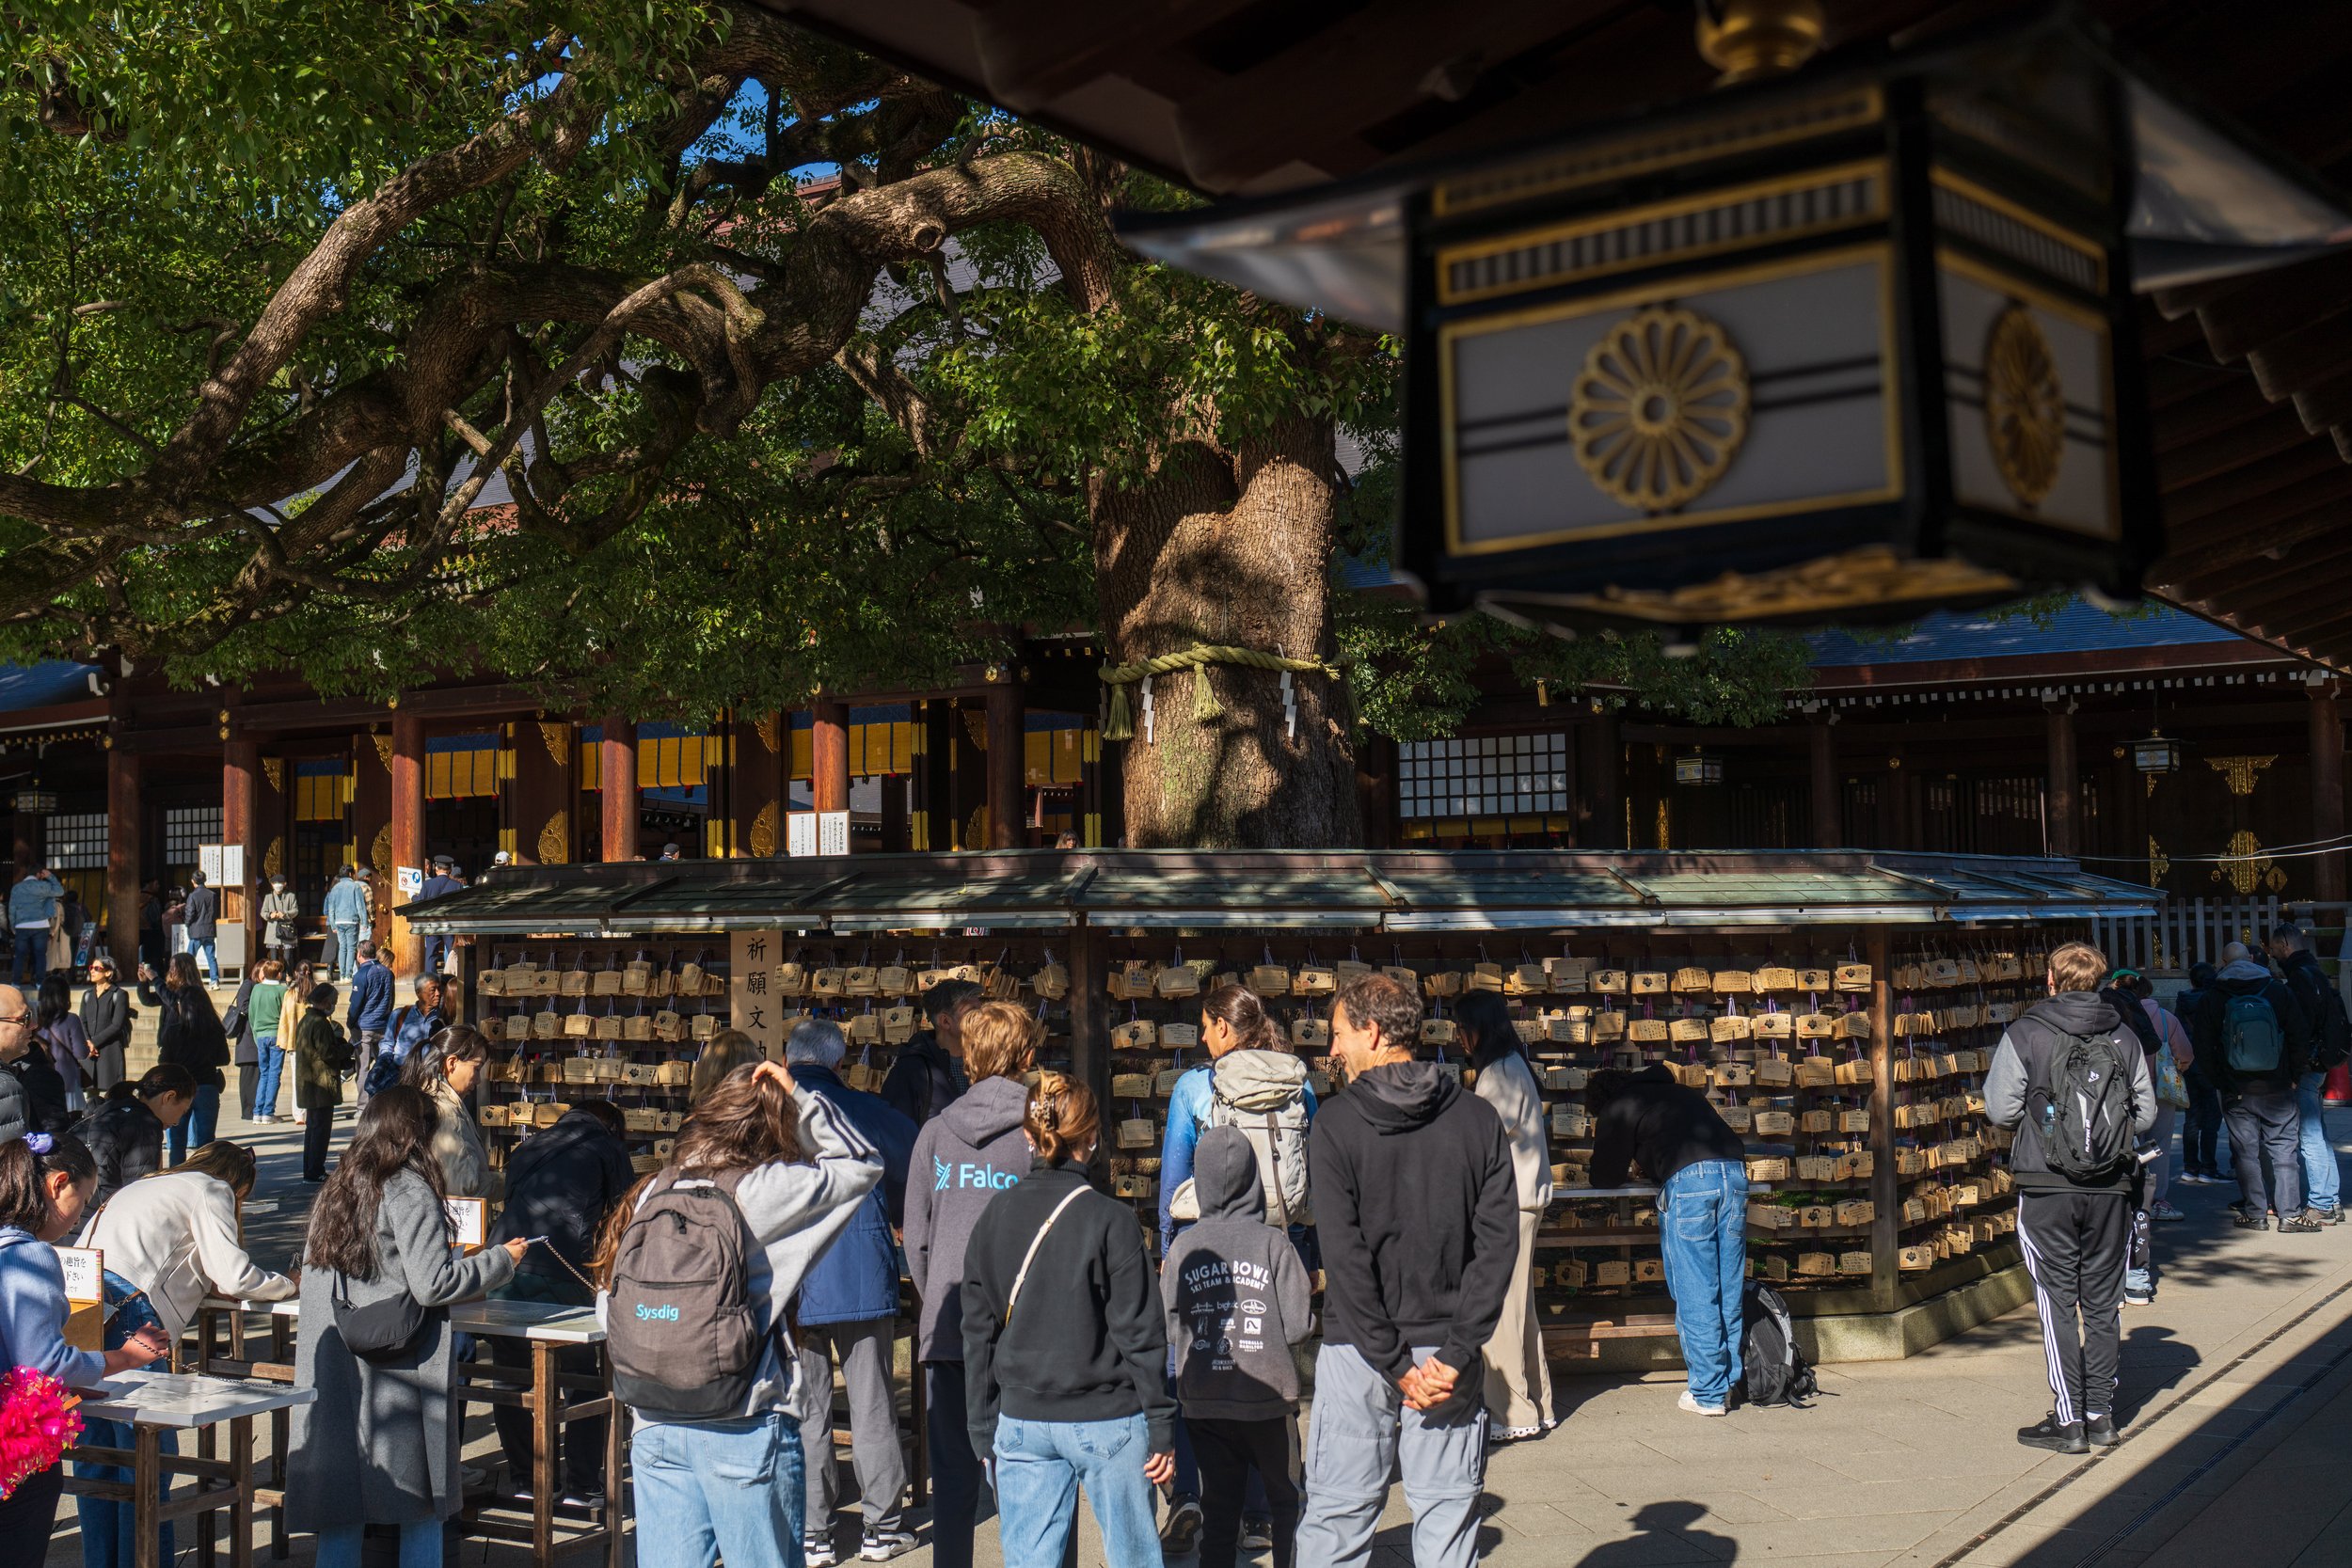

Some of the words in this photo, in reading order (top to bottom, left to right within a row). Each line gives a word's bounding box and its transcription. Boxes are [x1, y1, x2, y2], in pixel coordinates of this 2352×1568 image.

[960, 1164, 1019, 1189] Falco
[1185, 1261, 1229, 1285] SUGAR
[1233, 1260, 1269, 1284] BOWL
[1190, 1283, 1202, 1293] SKI
[1203, 1277, 1222, 1289] TEAM
[1232, 1275, 1265, 1291] ACADEMY
[636, 1304, 678, 1322] Sysdig
